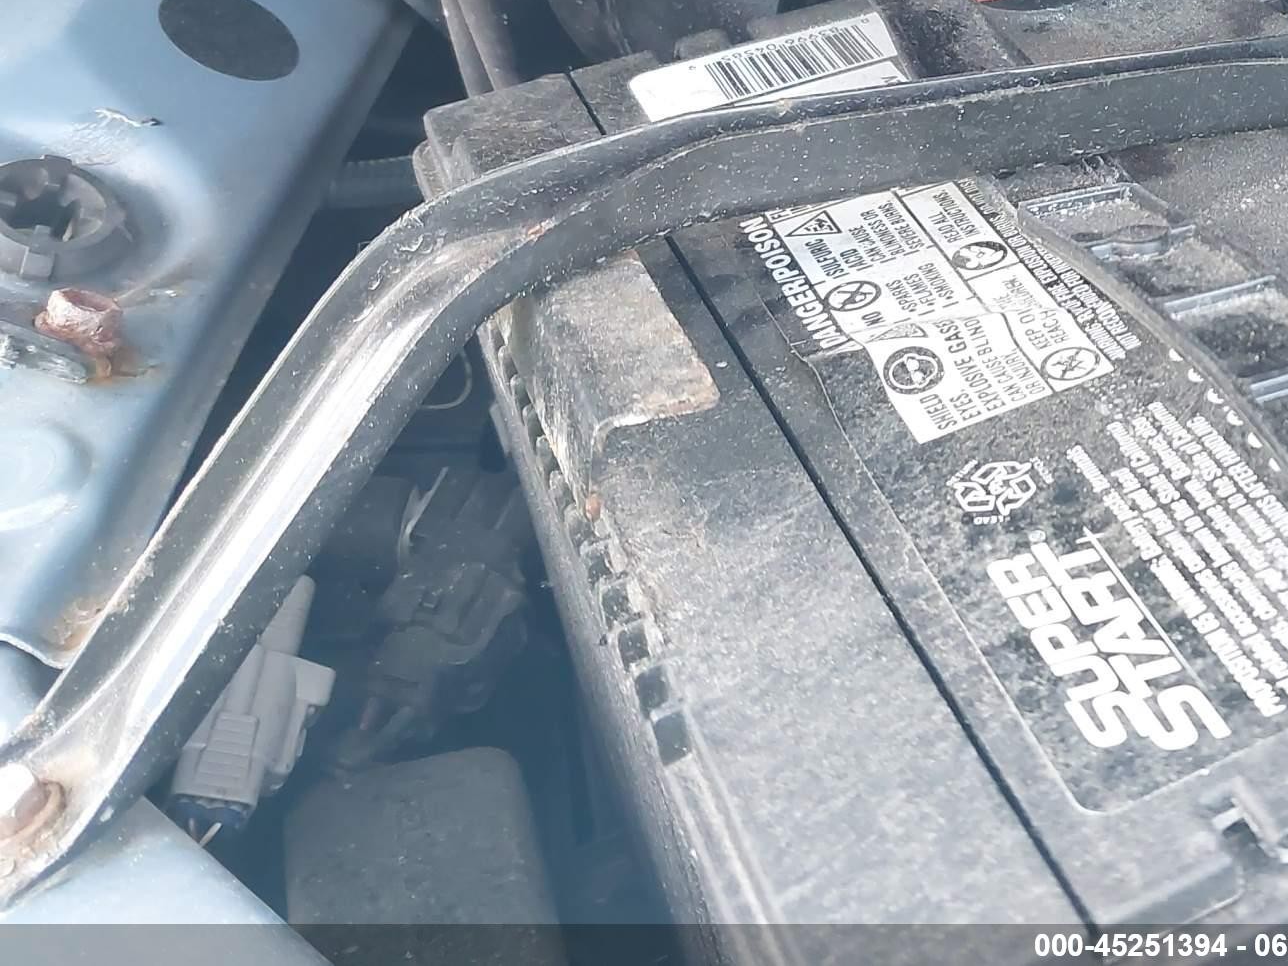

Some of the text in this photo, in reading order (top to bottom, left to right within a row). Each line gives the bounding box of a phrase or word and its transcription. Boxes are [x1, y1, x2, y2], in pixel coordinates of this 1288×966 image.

[878, 200, 924, 248] SEVERE BURNS.
[928, 211, 962, 243] READ ALL
[932, 189, 977, 234] INSTRUCTIONS.
[860, 209, 904, 255] BLINDNESS OR
[1007, 234, 1026, 247] OR
[805, 238, 843, 276] SULFURIC
[839, 248, 866, 267] ACID
[864, 246, 885, 261] CAN
[1016, 245, 1056, 283] EXPLOSION
[738, 215, 850, 349] DANGER/POISON
[1060, 270, 1083, 287] FOR
[861, 311, 883, 326] NO
[1040, 309, 1066, 343] REACH
[1024, 328, 1051, 349] KEEP
[1115, 332, 1141, 349] NOT
[955, 319, 1026, 401] CAN CAUSE BLIND
[954, 356, 1005, 411] EXPLOSIVE
[1024, 380, 1045, 394] OR
[919, 393, 957, 429] SHIELD
[949, 389, 981, 420] EYES.
[1131, 416, 1156, 440] also
[1146, 401, 1192, 446] California
[1106, 421, 1149, 467] California
[1143, 433, 1191, 479] Batteries
[1179, 441, 1202, 458] of
[1110, 467, 1140, 493] lead
[1136, 462, 1159, 476] of
[1192, 451, 1221, 480] State
[1228, 461, 1268, 497] AFTER
[1126, 488, 1156, 510] and
[1149, 473, 1179, 503] State
[1212, 476, 1236, 497] the
[1223, 493, 1246, 509] to
[1142, 507, 1174, 535] lead
[1170, 499, 1193, 520] the
[1184, 516, 1203, 532] to
[1237, 504, 1275, 542] known
[1123, 517, 1161, 559] Battery
[1162, 530, 1205, 572] contain
[1192, 527, 1231, 567] known
[1207, 505, 1268, 570] reproductive
[1195, 569, 1256, 636] accessories
[1221, 562, 1276, 619] chemicals
[984, 549, 1151, 747] SUPER
[1028, 540, 1235, 746] START
[1205, 629, 1284, 715] PROPOSITION
